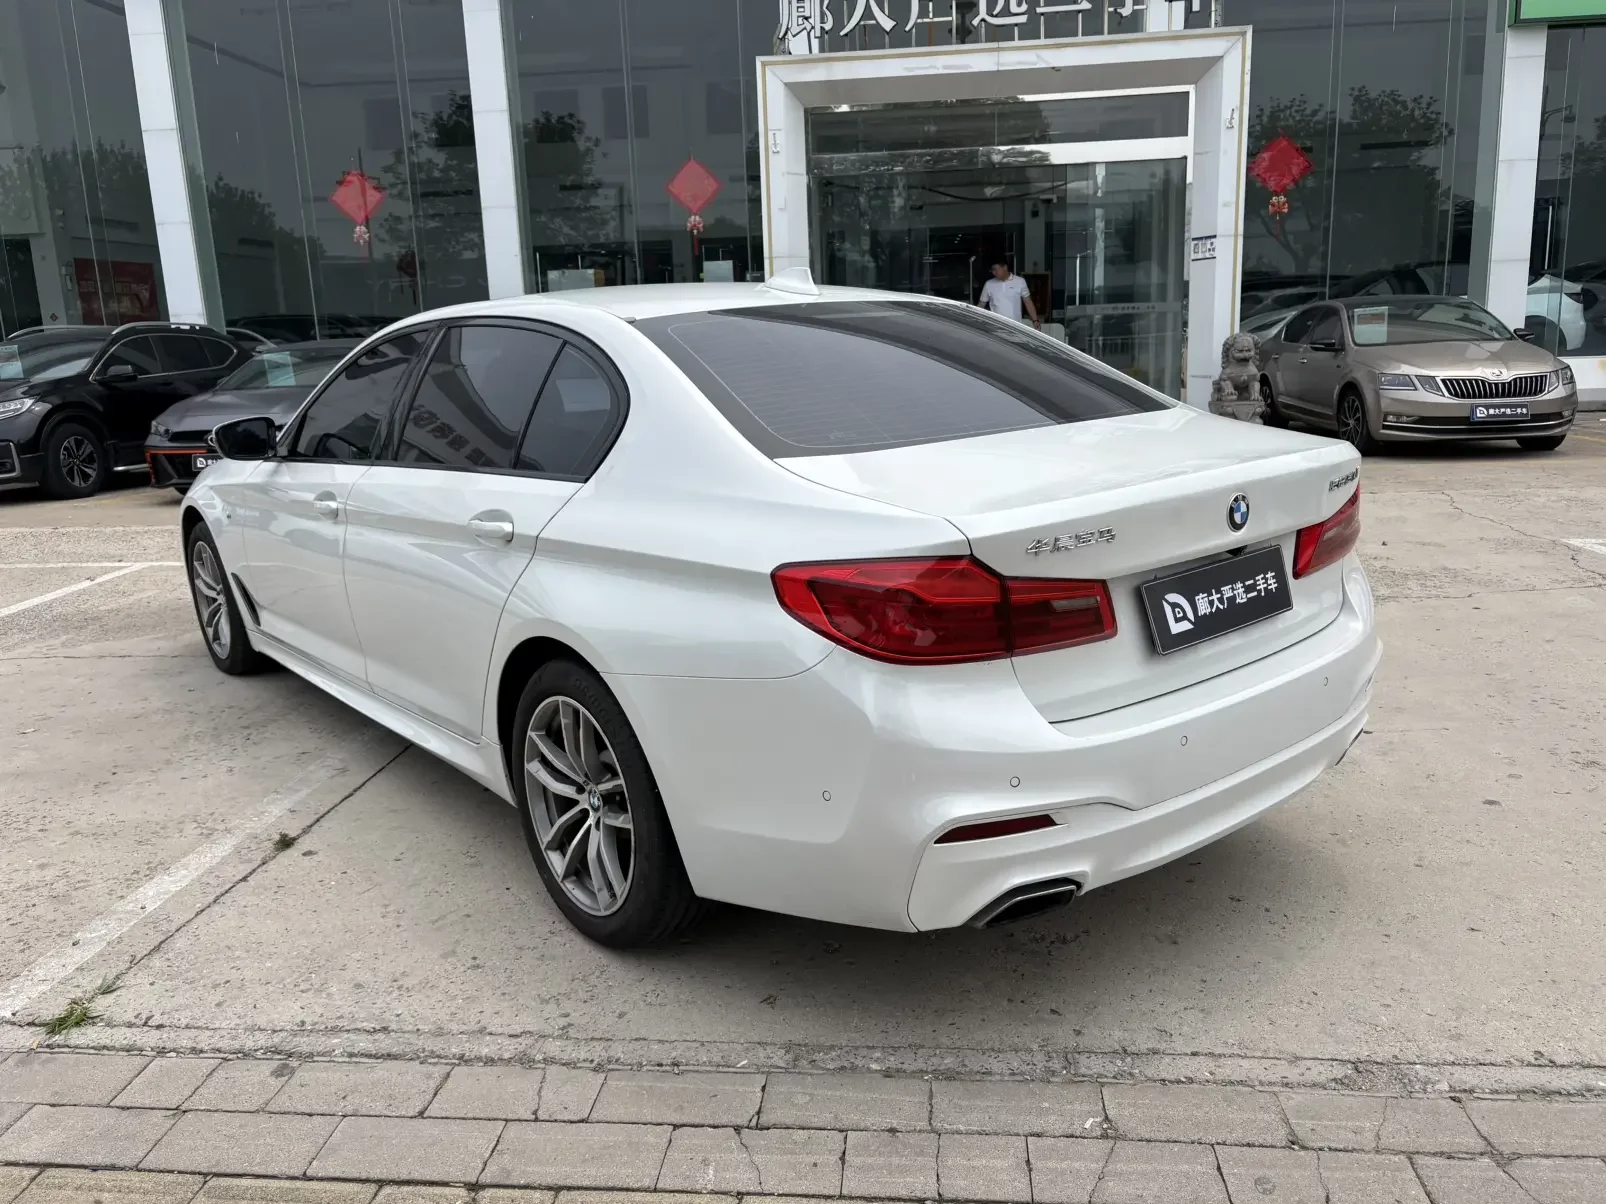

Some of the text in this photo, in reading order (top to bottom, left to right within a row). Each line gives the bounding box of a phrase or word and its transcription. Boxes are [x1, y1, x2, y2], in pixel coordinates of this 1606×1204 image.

[1026, 526, 1117, 556] 华晨宝马
[1194, 570, 1279, 617] 廊大严选二手车
